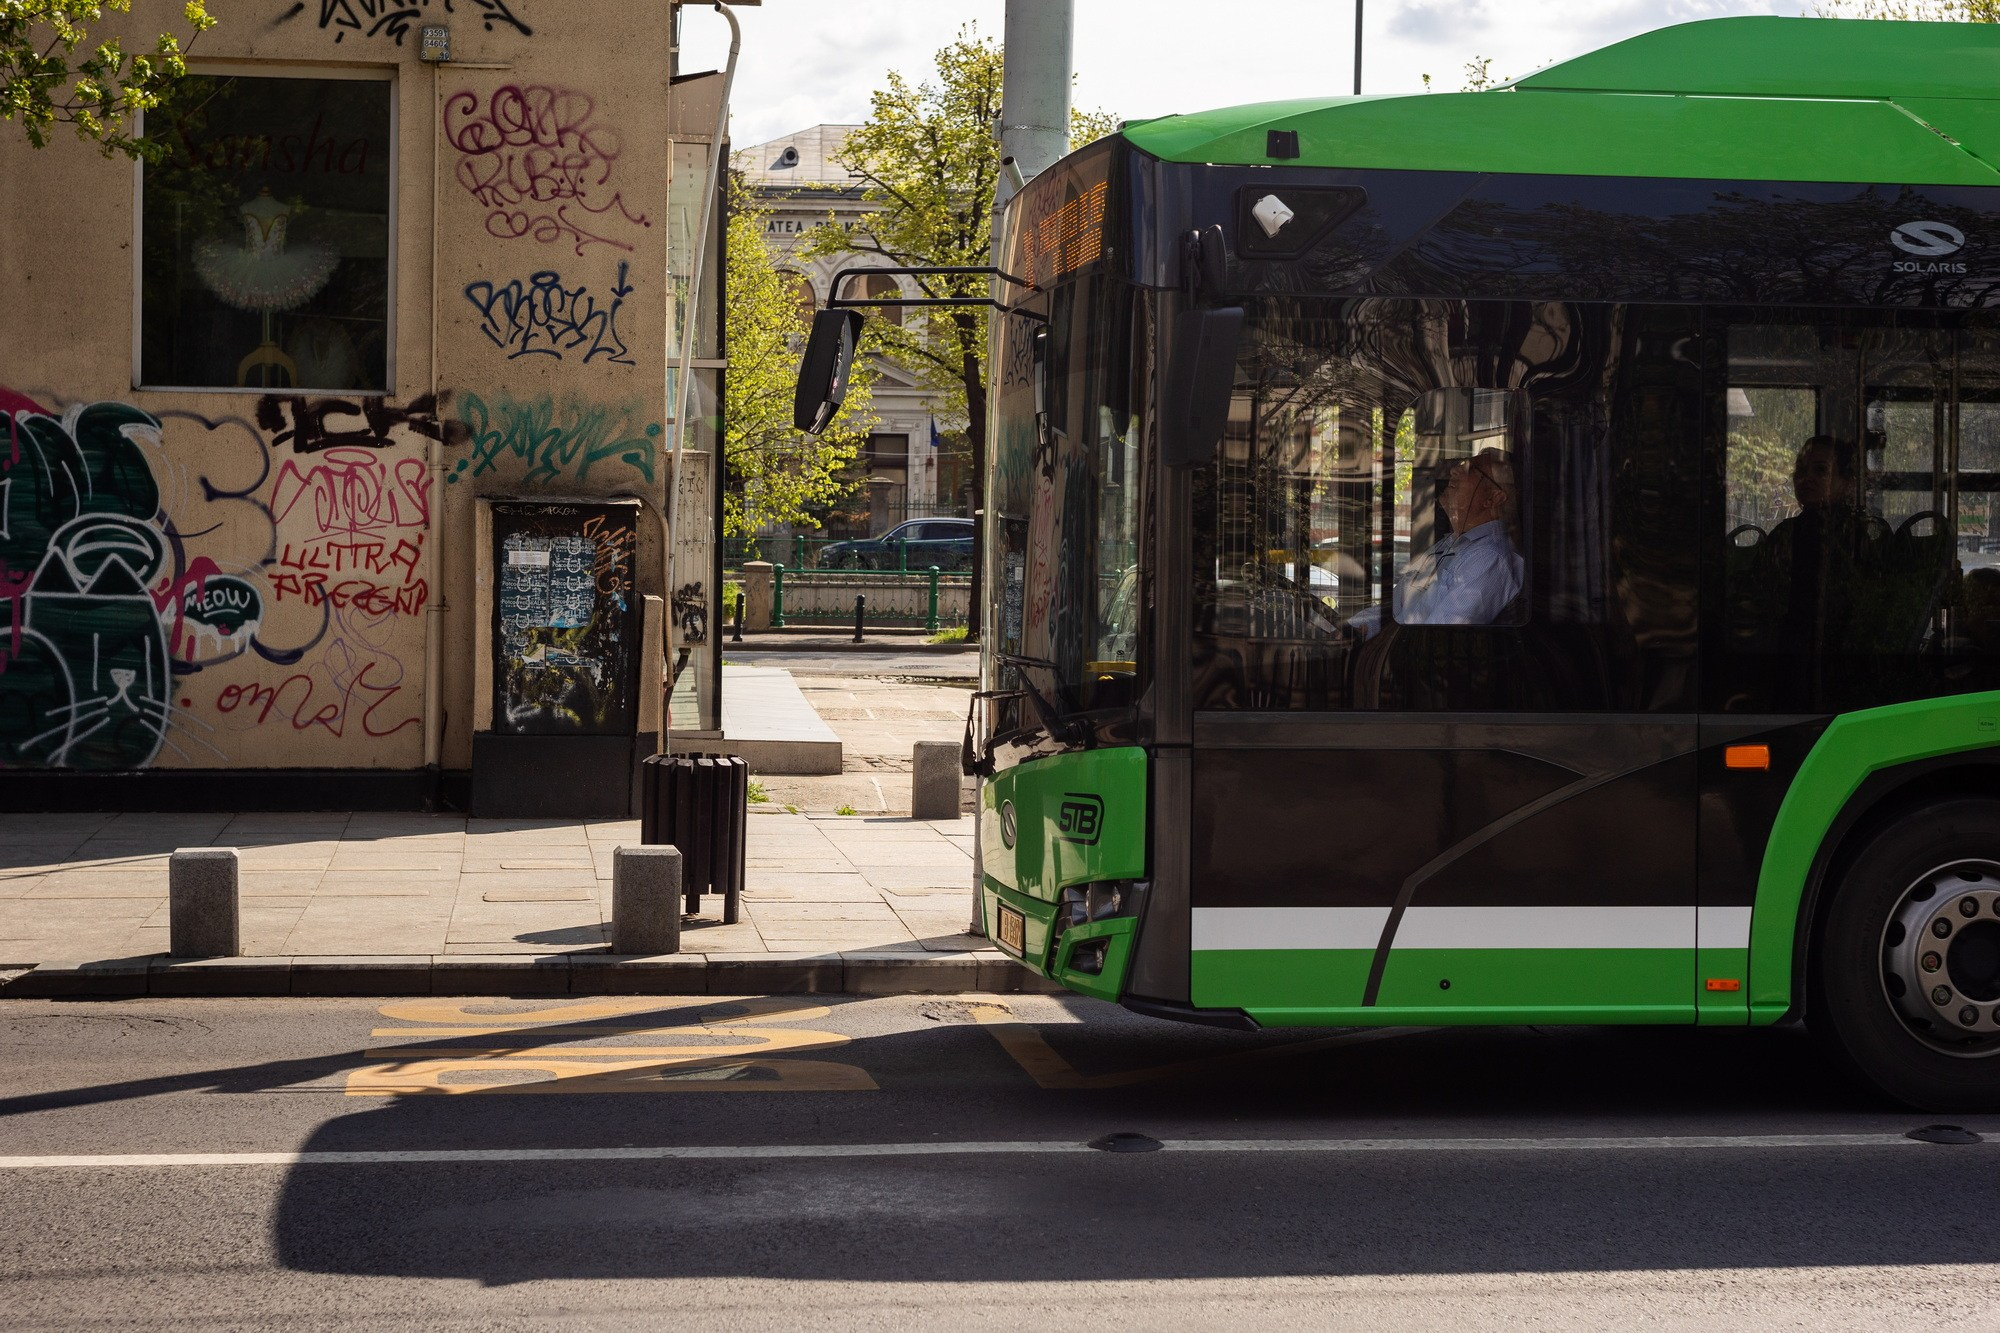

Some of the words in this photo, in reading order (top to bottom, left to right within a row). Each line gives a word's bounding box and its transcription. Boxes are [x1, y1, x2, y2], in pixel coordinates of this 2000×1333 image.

[168, 110, 370, 176] Sansha
[1893, 261, 1967, 274] SOLARIS
[185, 588, 251, 613] MEOW
[1059, 802, 1098, 835] STB
